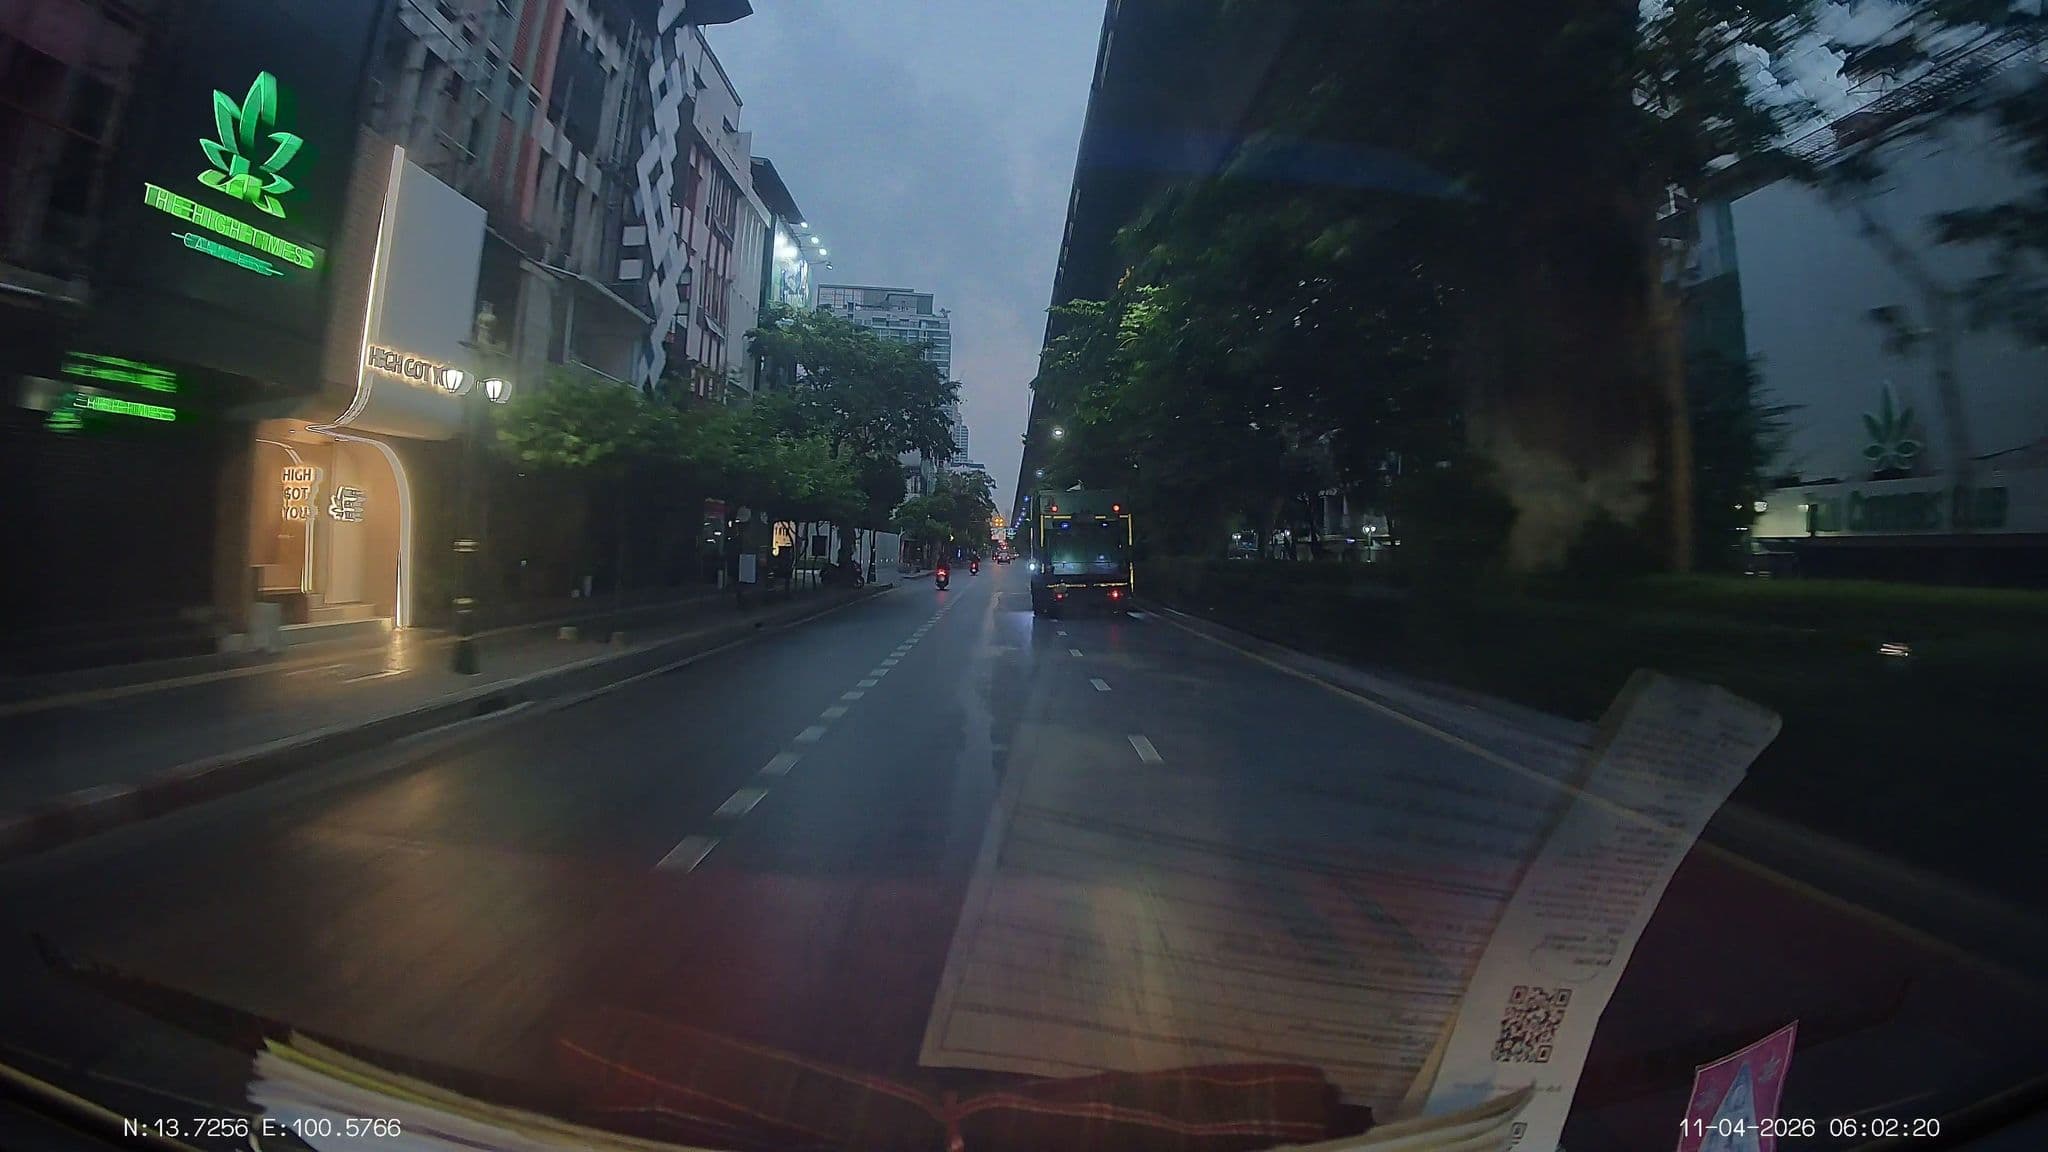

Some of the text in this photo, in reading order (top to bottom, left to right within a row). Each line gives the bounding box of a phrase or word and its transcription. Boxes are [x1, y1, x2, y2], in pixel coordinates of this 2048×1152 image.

[144, 183, 194, 222] THE
[192, 203, 242, 242] HIGH
[368, 345, 402, 374] HIGH
[404, 358, 432, 382] GOT
[283, 468, 312, 481] HIGH
